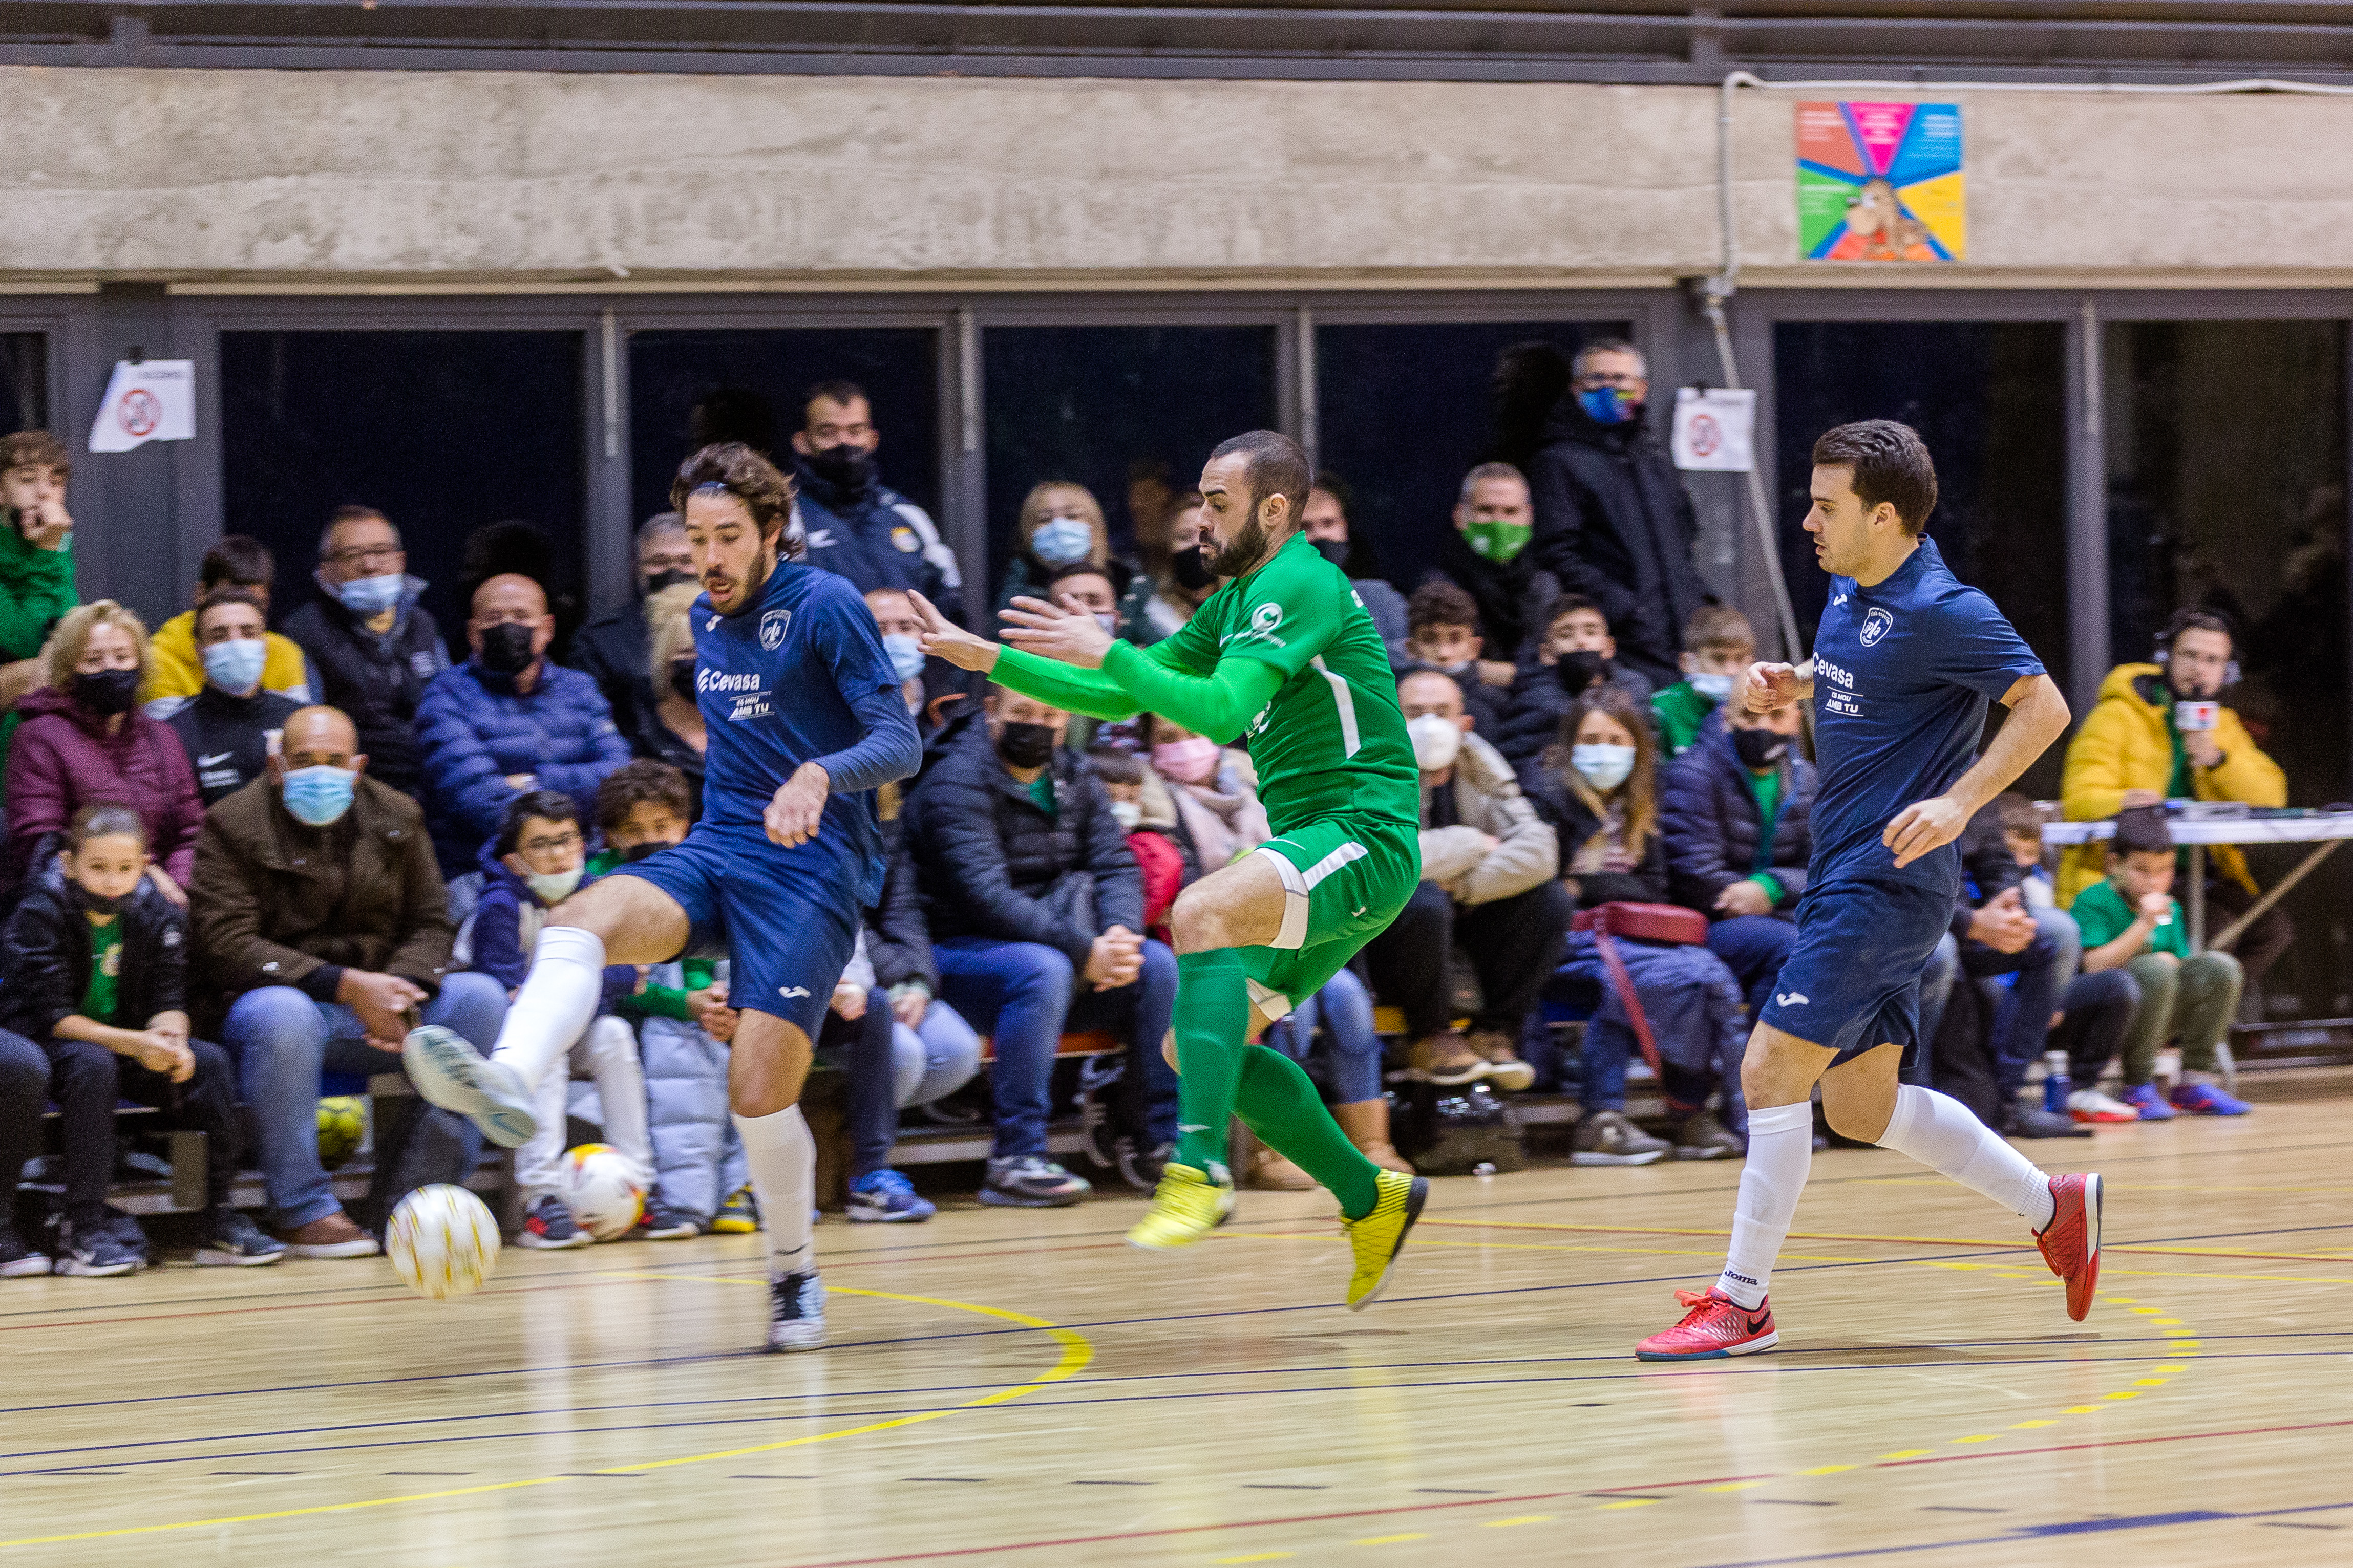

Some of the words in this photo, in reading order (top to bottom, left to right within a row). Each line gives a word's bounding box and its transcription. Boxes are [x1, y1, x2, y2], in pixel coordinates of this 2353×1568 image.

[1812, 652, 1854, 690] Cevasa
[709, 670, 760, 692] Cevasa
[1837, 694, 1852, 702] MOU
[754, 702, 770, 715] TU
[1826, 699, 1842, 711] AMB
[1845, 703, 1859, 713] TU
[1725, 1270, 1758, 1286] Joma
